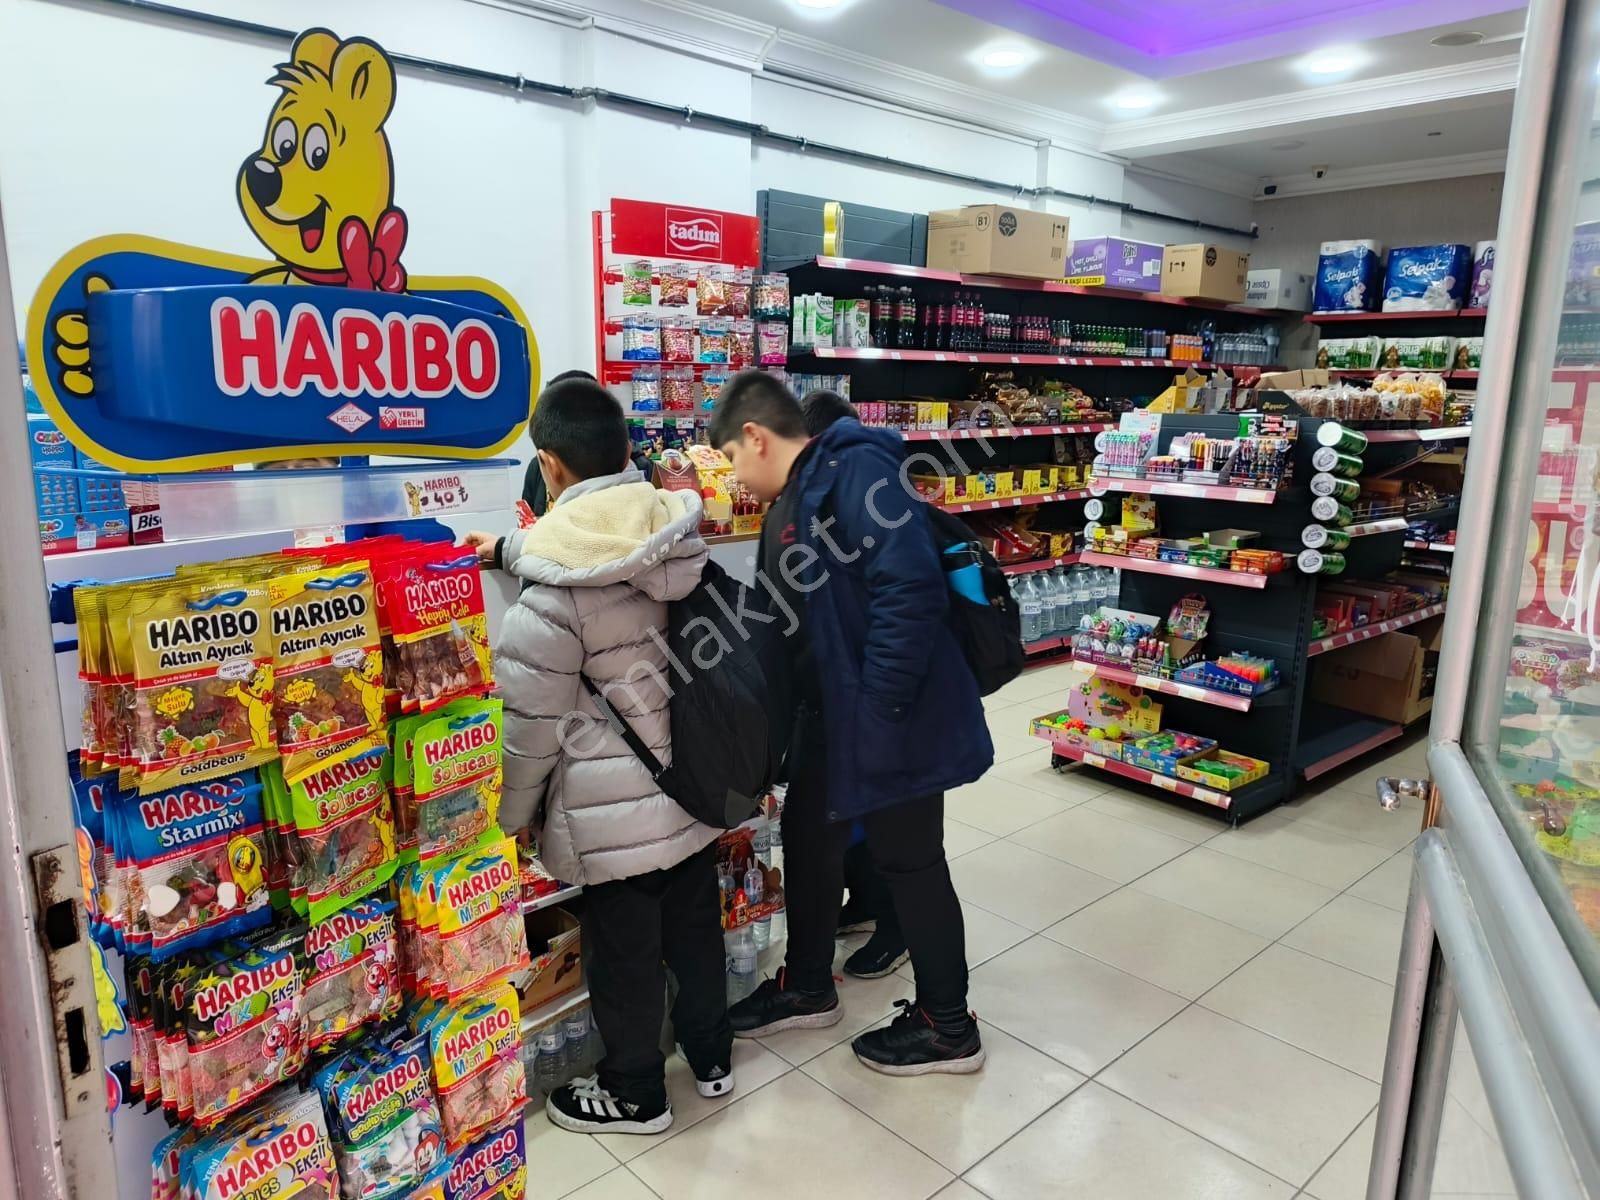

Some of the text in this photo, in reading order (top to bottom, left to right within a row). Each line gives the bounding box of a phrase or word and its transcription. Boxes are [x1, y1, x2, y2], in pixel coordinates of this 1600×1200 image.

[667, 222, 721, 245] tadım
[1324, 266, 1360, 283] Selpak
[1399, 257, 1443, 278] Selpak
[211, 296, 500, 399] HARIBO
[335, 414, 365, 423] HELAL
[397, 418, 424, 427] ÜRETİM
[398, 409, 418, 419] YERLİ
[424, 476, 460, 492] HARIBO
[404, 573, 474, 612] HARIBO
[148, 609, 259, 649] HARIBO
[271, 594, 367, 635] HARIBO
[416, 602, 470, 626] Happy Cola
[159, 640, 254, 668] Altın Ayıcık
[279, 624, 366, 656] Altın Ayıcık
[425, 722, 498, 765] HARIBO
[180, 752, 246, 777] Goldbears
[432, 750, 498, 785] Solucan
[160, 810, 240, 848] Starmix
[447, 861, 514, 910] HARIBO
[194, 951, 295, 1022] HARIBO
[443, 1008, 513, 1067] HARIBO
[345, 1054, 422, 1121] HARIBO
[214, 1121, 317, 1198] HARIBO
[448, 1129, 518, 1193] HARIBO
